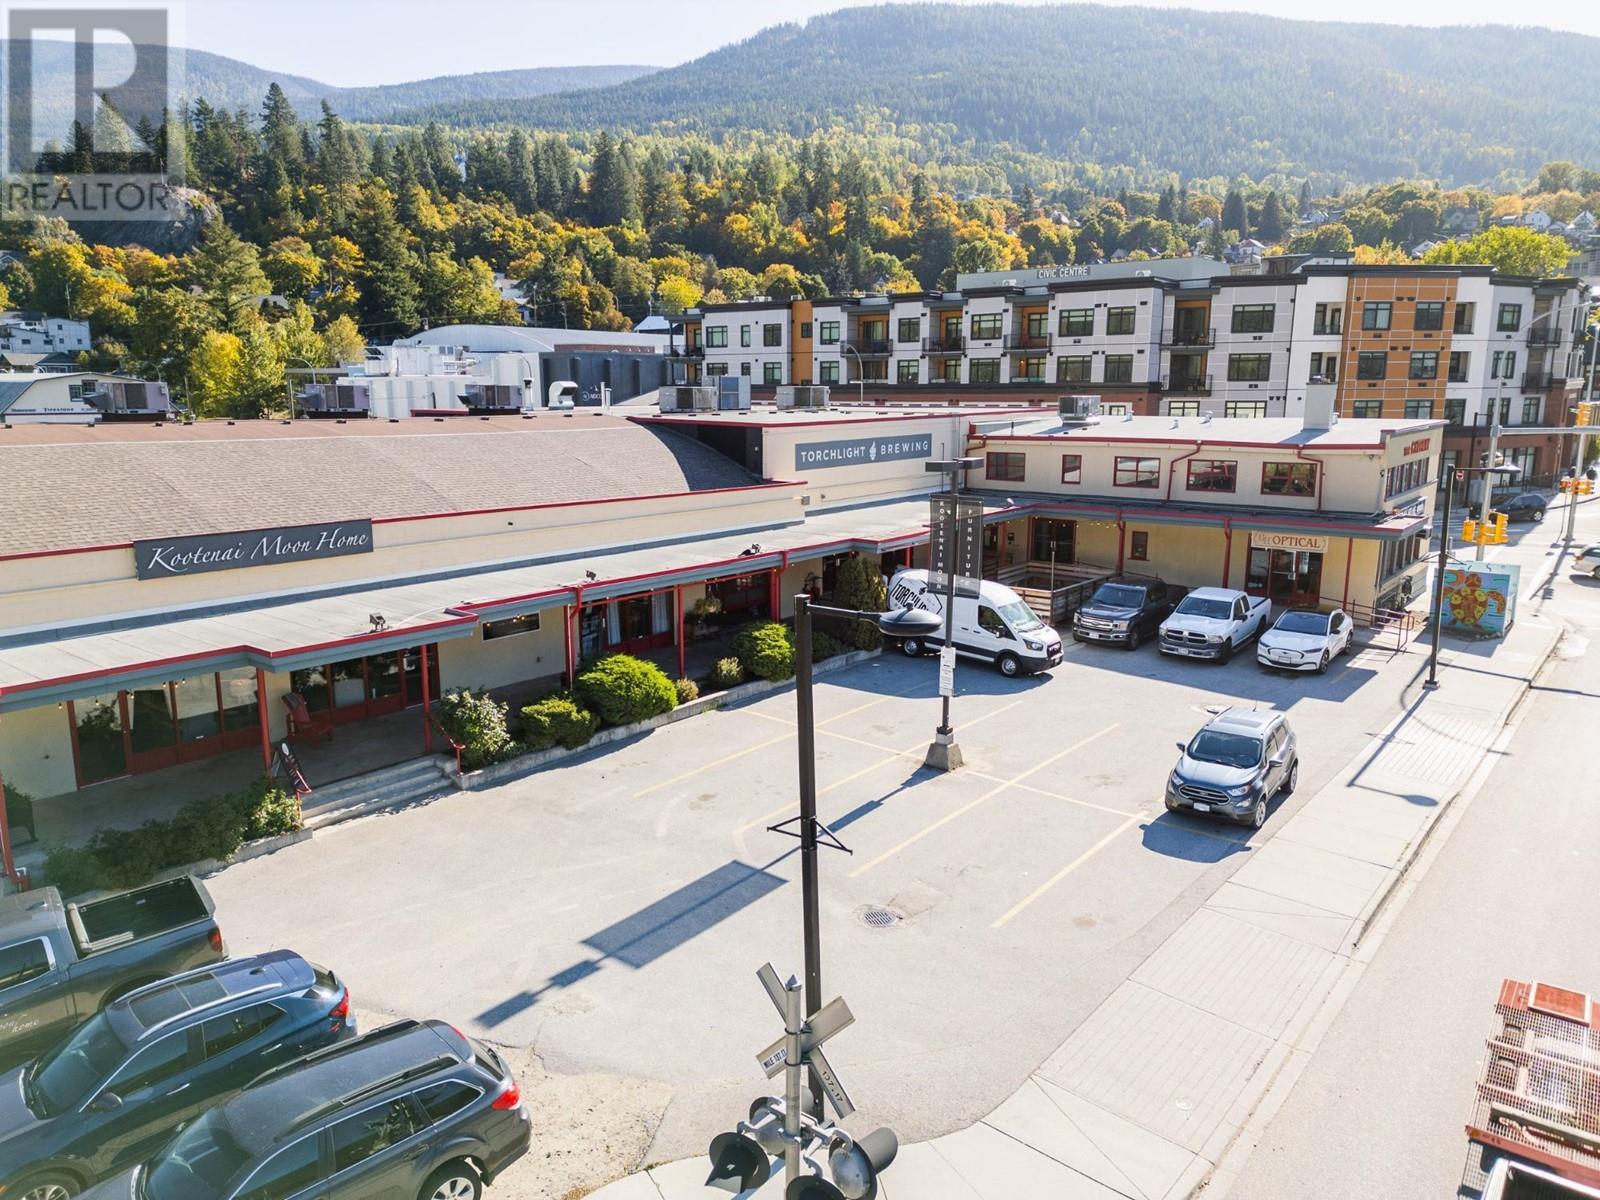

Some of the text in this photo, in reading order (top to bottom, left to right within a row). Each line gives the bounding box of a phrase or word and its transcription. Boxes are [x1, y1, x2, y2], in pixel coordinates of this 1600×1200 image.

[1038, 266, 1088, 279] CIVIC CENTRE
[801, 441, 928, 462] TORCHLIGHT BREWING
[148, 527, 369, 572] Kootenai Moon Home
[1272, 535, 1320, 549] OPTICAL
